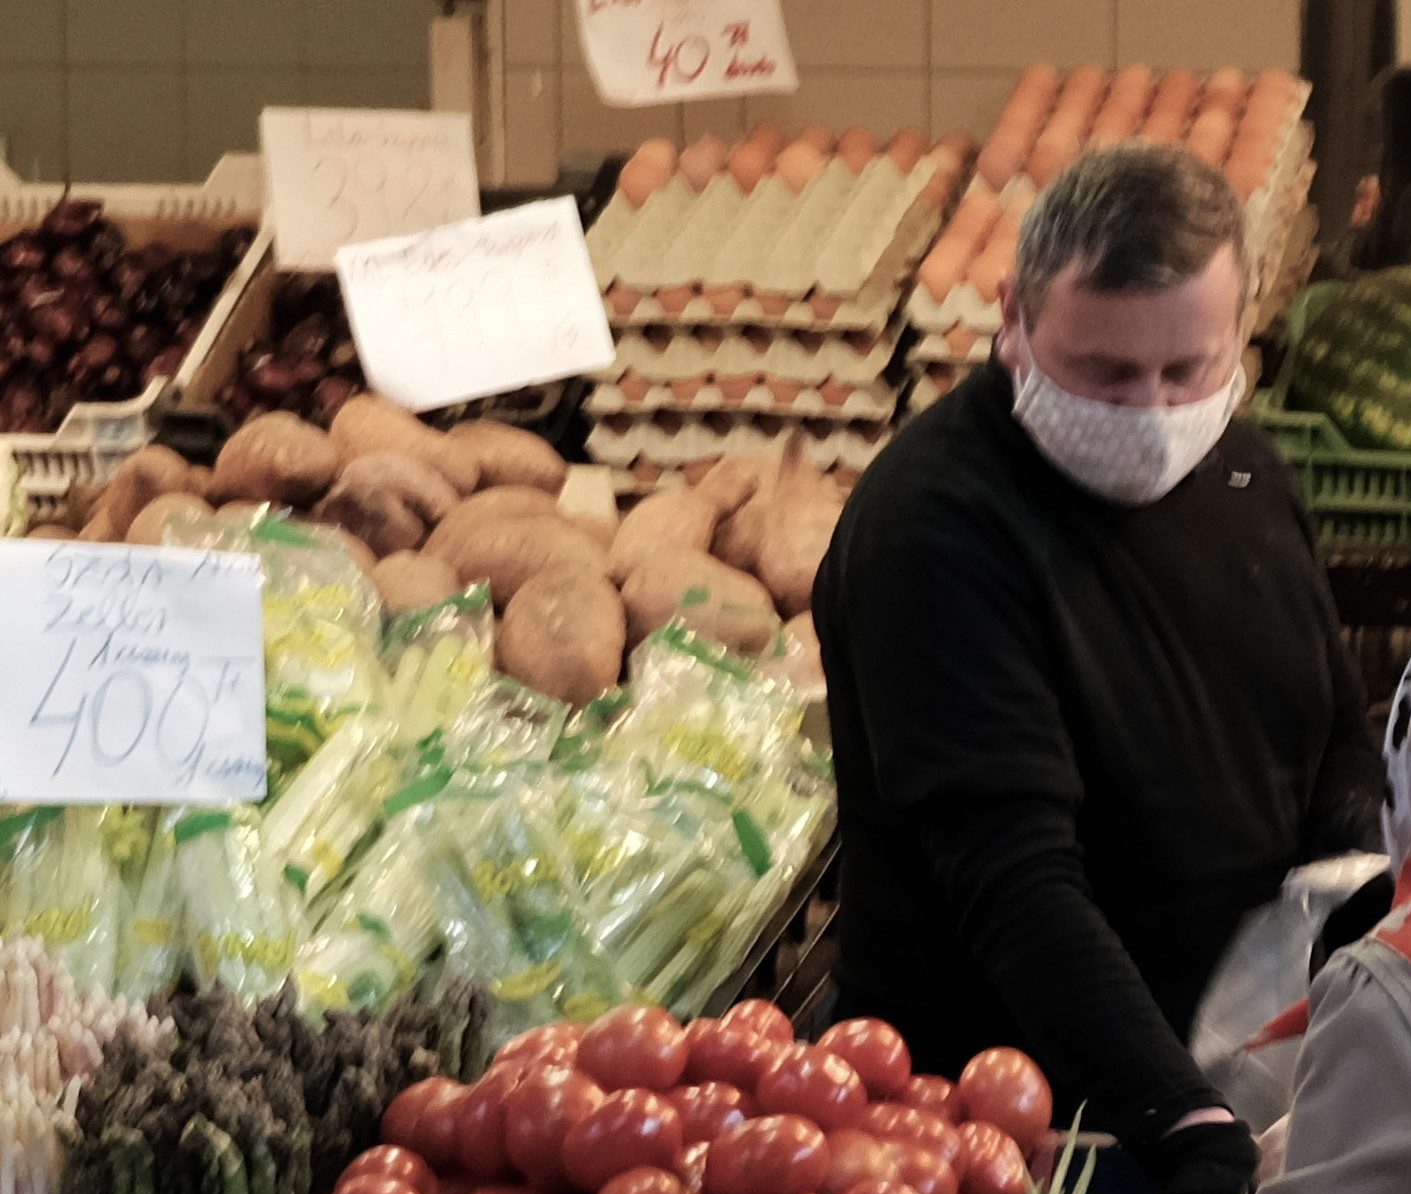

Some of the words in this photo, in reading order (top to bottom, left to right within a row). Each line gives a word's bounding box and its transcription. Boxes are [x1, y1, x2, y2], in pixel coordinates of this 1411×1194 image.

[646, 20, 711, 88] 40
[29, 637, 210, 780] 400
[200, 654, 256, 705] Ft
